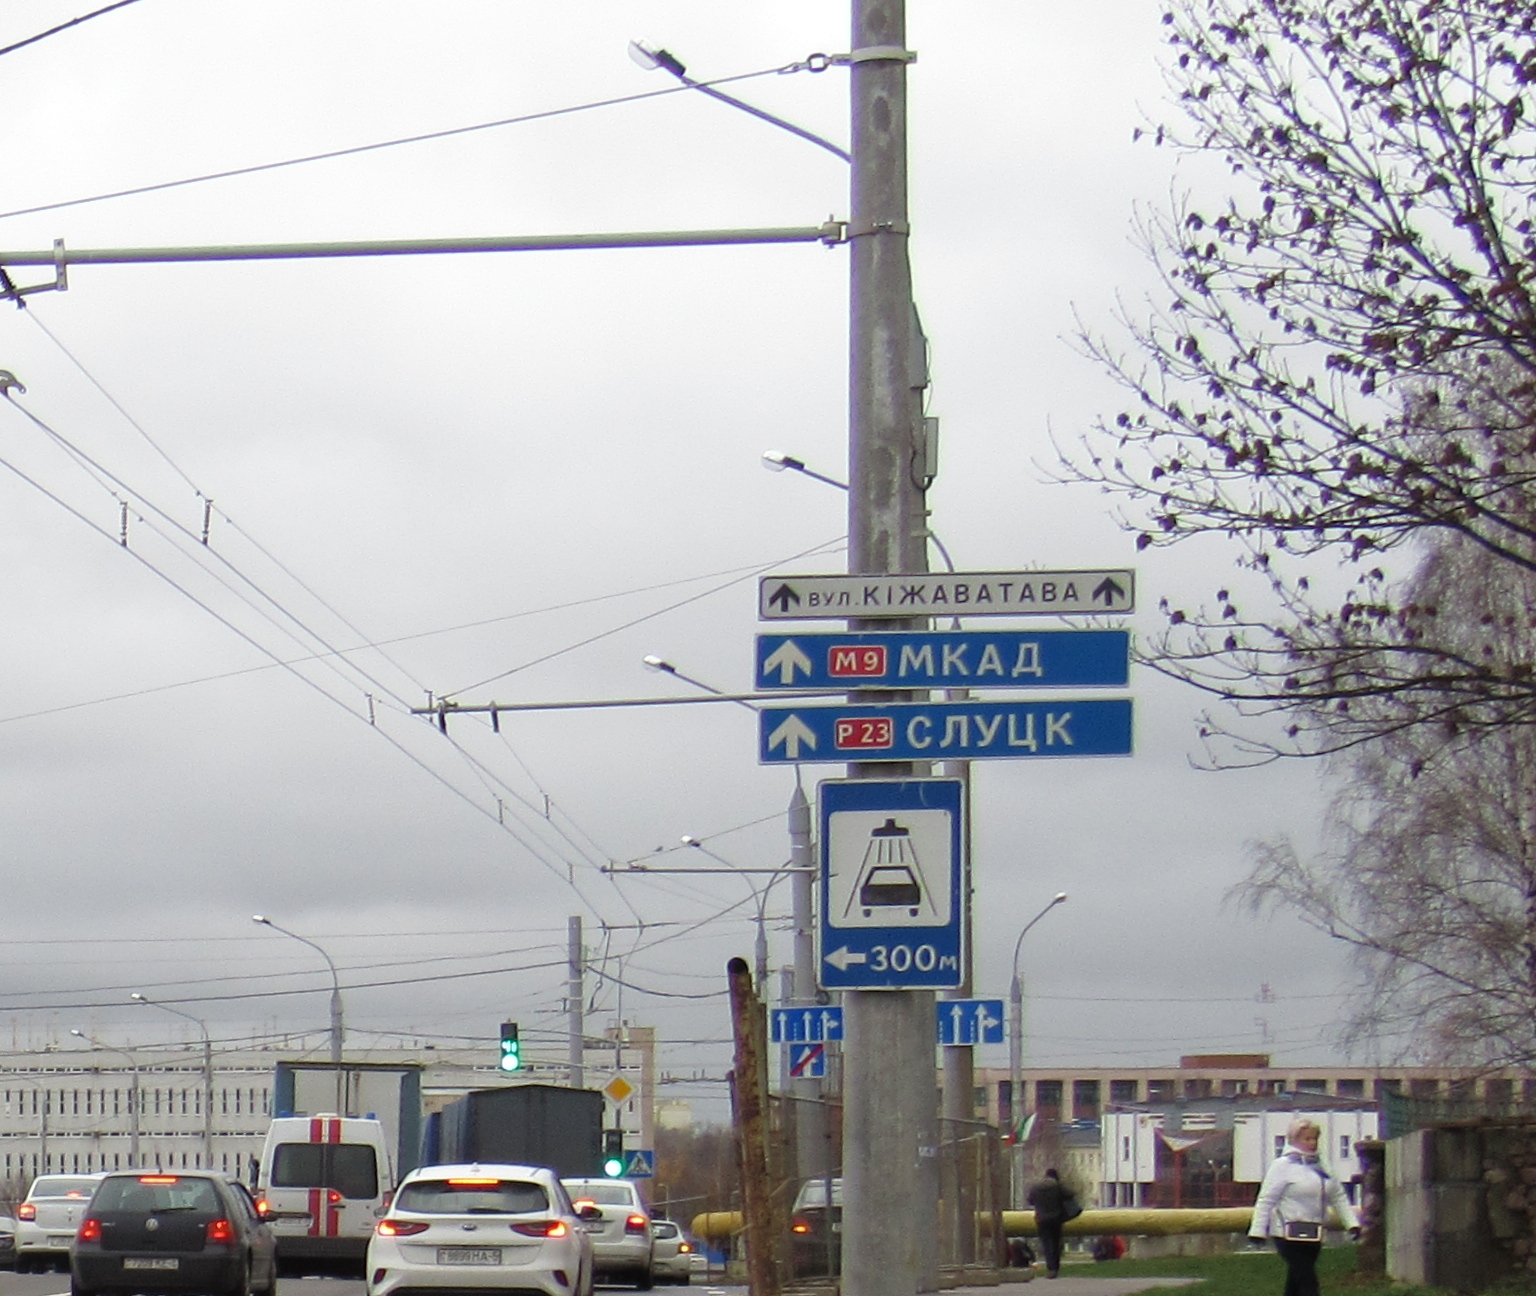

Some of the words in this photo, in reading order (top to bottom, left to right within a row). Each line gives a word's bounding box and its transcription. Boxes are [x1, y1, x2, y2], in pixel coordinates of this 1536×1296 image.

[863, 583, 1080, 607] КІЖАВАТАВА
[898, 642, 1043, 678] МКАД
[906, 712, 1074, 751] СЛУЦК
